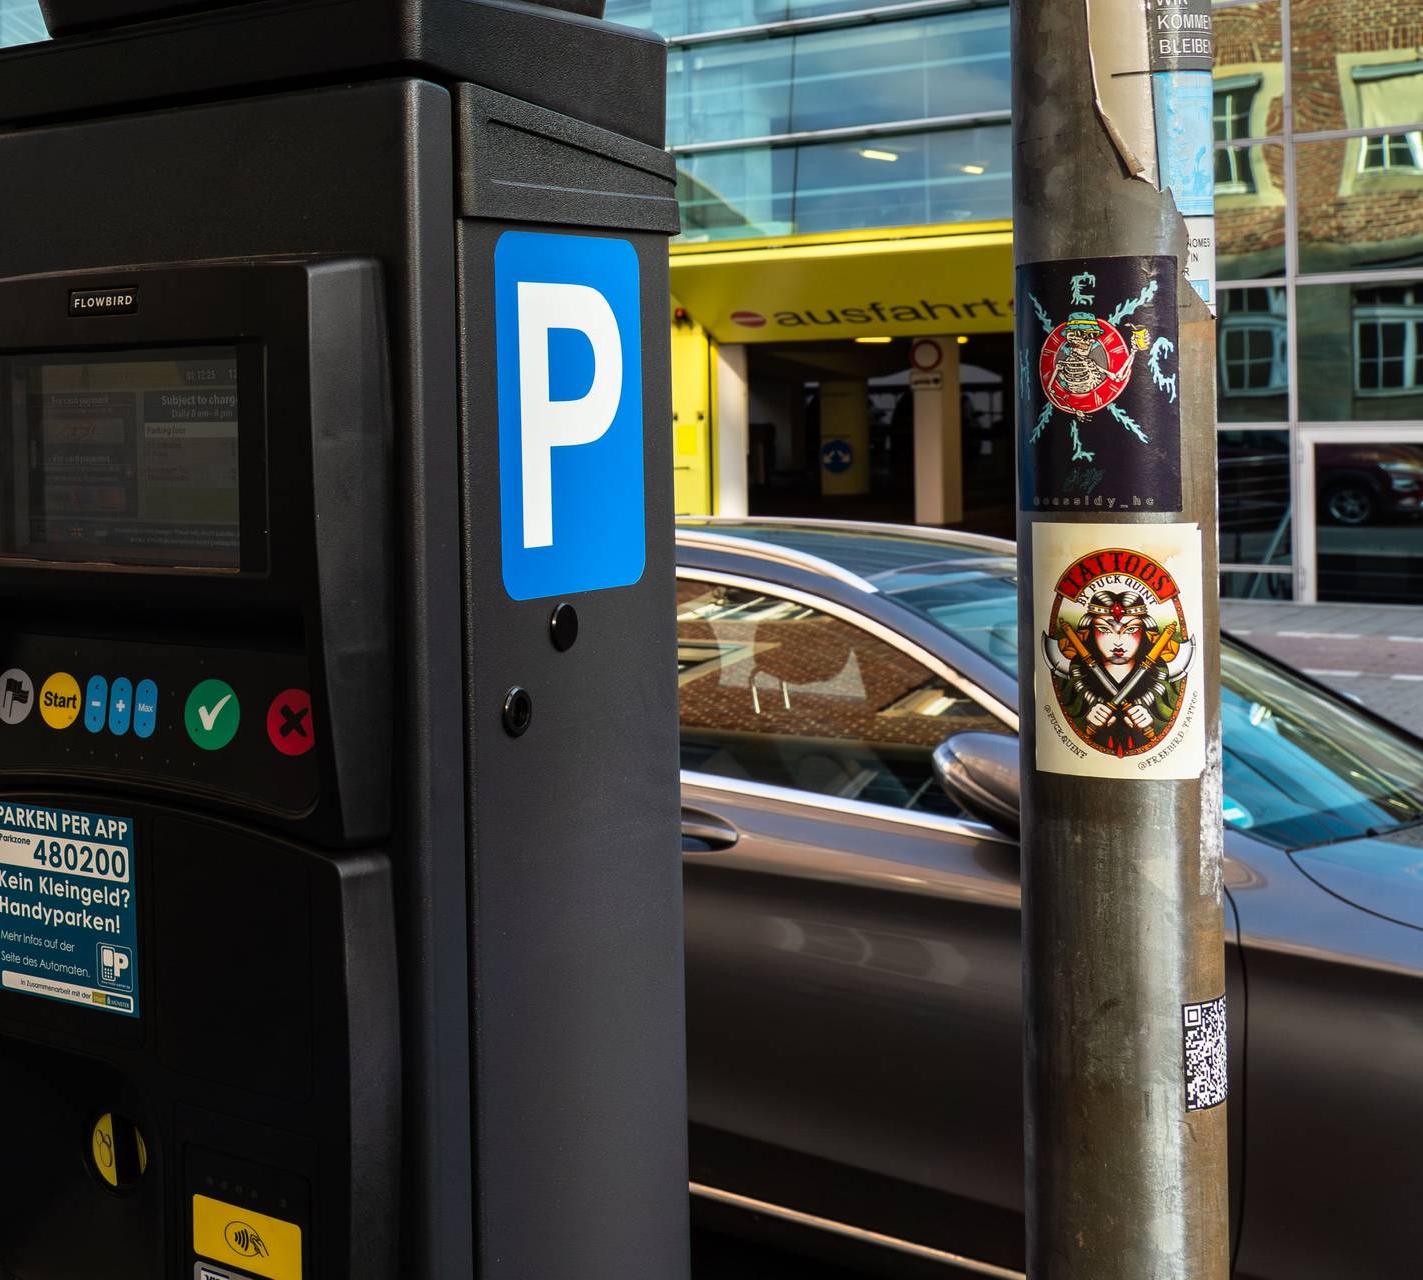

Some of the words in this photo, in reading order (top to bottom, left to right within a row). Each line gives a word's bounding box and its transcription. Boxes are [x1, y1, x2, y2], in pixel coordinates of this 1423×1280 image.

[1157, 14, 1211, 30] KOMME
[1159, 38, 1211, 54] BLEIBE
[74, 295, 133, 309] FLOWBIRD
[773, 298, 1008, 328] ausfahrt
[161, 394, 196, 408] Subject
[197, 394, 208, 405] to
[209, 393, 238, 407] charg
[171, 409, 190, 419] Daily
[517, 281, 623, 548] P
[146, 426, 171, 436] Parking
[1061, 552, 1169, 592] TATTOOS
[1077, 590, 1092, 607] BY
[1088, 575, 1122, 593] PUCK
[1124, 576, 1158, 606] QUINT
[43, 691, 78, 709] Start
[138, 703, 153, 713] Max
[61, 813, 91, 836] PER
[94, 818, 128, 841] APP
[33, 839, 126, 879] 480200
[39, 876, 130, 908] Kleingeld?
[0, 896, 120, 934] Handyparken!
[0, 930, 21, 941] Mehr
[23, 935, 43, 947] Infos
[43, 939, 58, 949] auf
[59, 940, 75, 952] der
[1, 950, 21, 963] Seite
[22, 955, 38, 968] des
[39, 959, 92, 978] Automaten.
[26, 980, 71, 996] Zusammenarbeit
[71, 989, 81, 997] mit
[81, 992, 91, 1000] der
